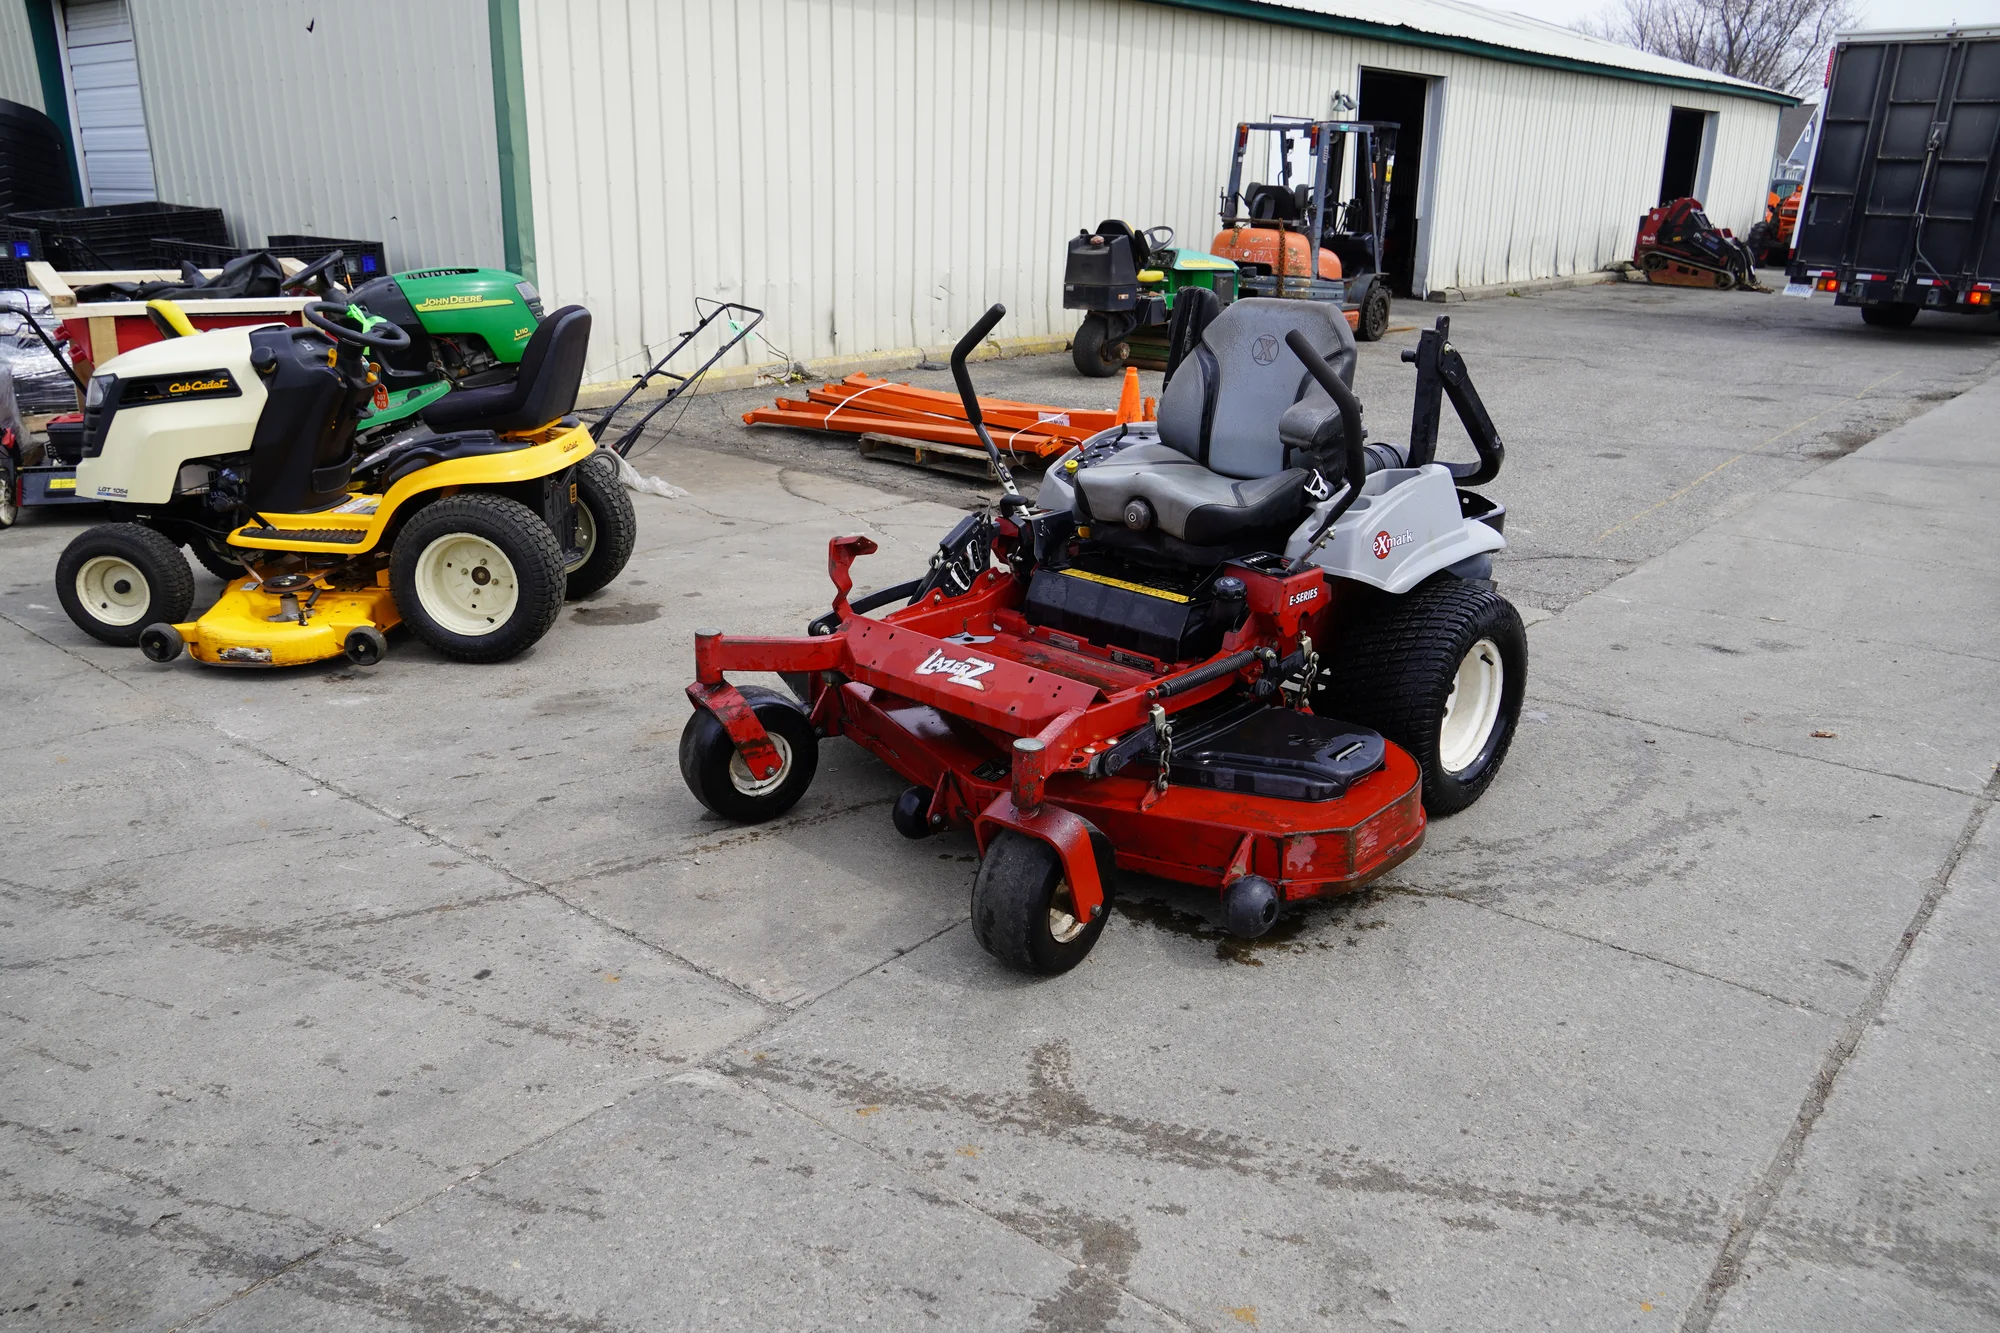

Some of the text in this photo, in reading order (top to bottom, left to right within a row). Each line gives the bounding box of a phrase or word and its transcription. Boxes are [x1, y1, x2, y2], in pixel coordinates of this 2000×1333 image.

[423, 295, 483, 307] JOHN DEERE
[169, 379, 229, 393] Cub Cadet
[113, 487, 128, 495] 1054
[1372, 529, 1414, 556] eXmark
[1289, 587, 1319, 606] E-SERIES
